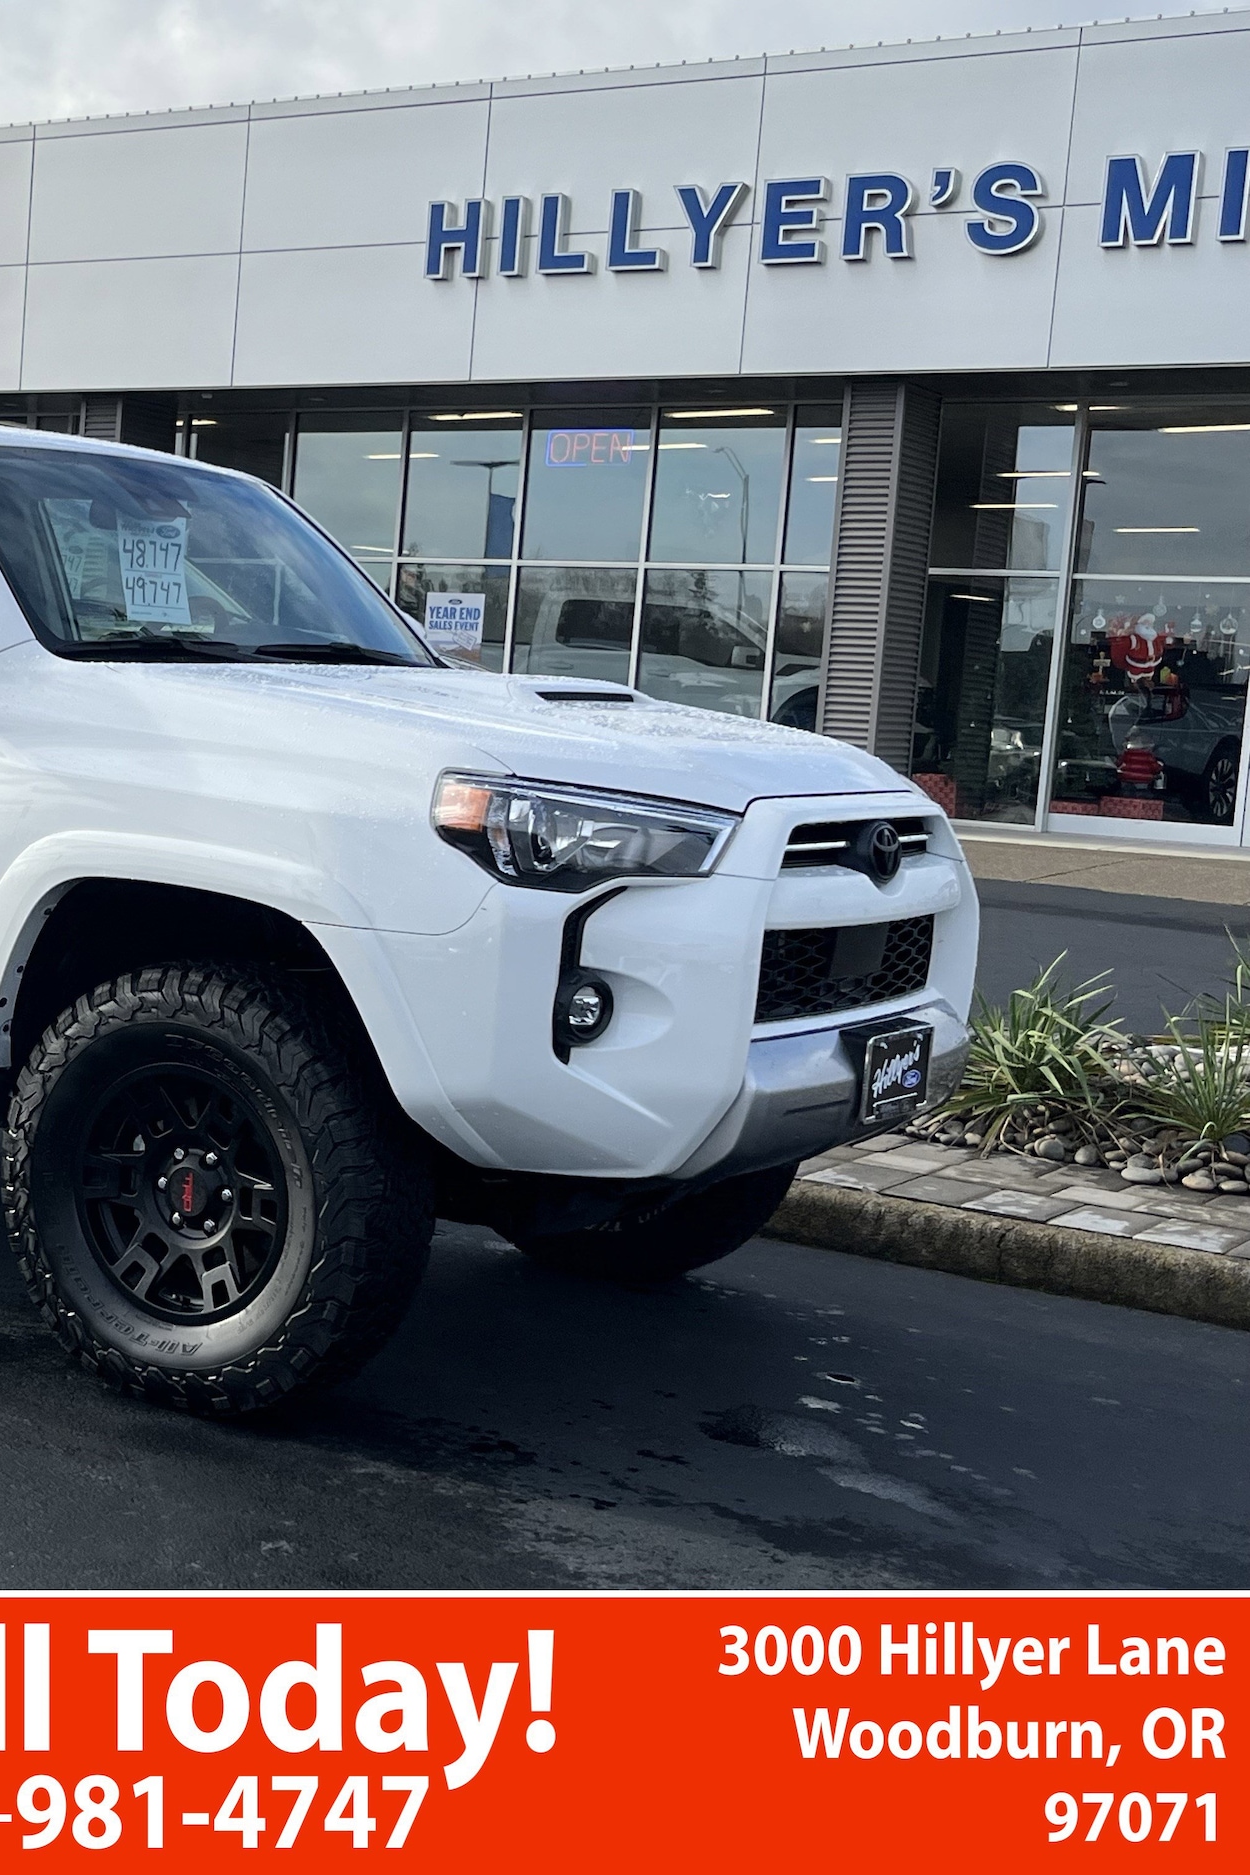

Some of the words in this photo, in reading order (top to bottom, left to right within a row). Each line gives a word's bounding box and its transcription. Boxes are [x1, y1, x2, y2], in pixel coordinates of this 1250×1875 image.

[425, 160, 1046, 280] HILLYER'S
[549, 432, 631, 463] OPEN
[429, 606, 457, 620] YEAR
[459, 607, 481, 621] END
[428, 620, 453, 630] SALES
[454, 621, 479, 632] EVENT
